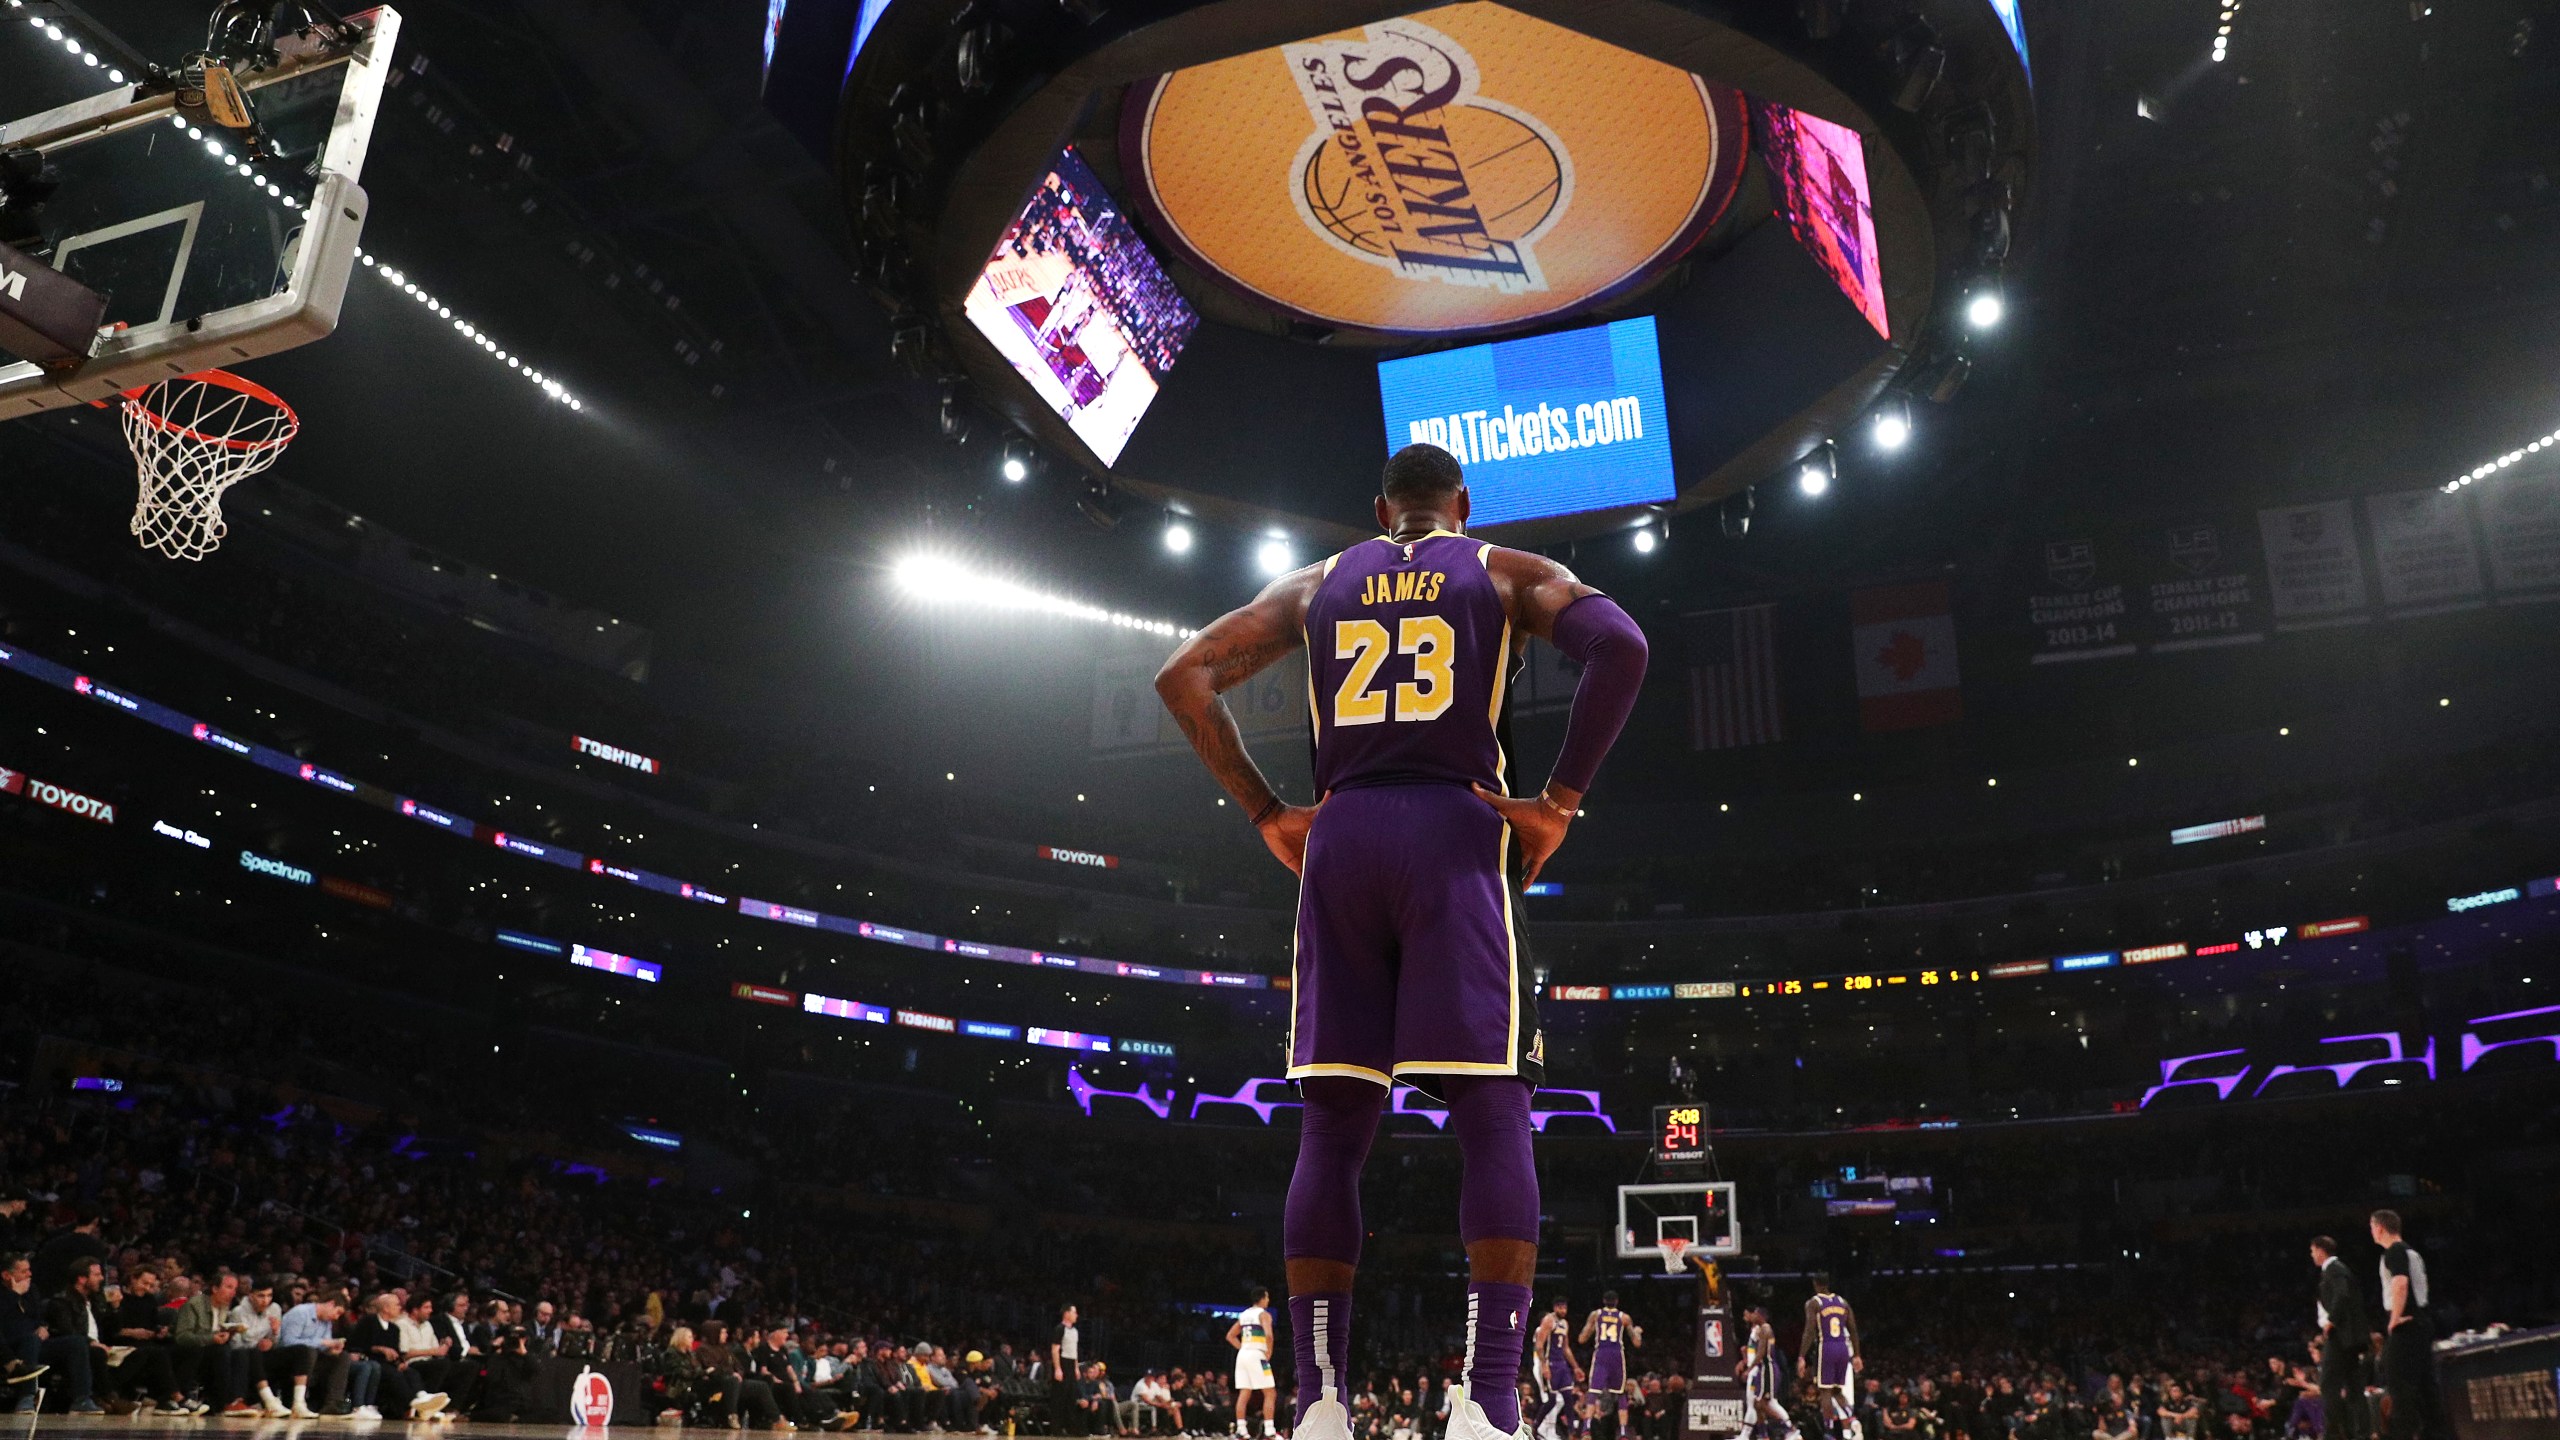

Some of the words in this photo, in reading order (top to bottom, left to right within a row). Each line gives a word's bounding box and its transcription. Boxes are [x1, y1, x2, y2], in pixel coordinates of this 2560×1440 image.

[1302, 57, 1383, 189] ANGELES
[1341, 30, 1531, 284] LAKERS
[1366, 191, 1404, 233] LOS
[1361, 571, 1446, 605] JAMES
[2170, 612, 2239, 633] 2011-12
[2048, 623, 2117, 645] 2013-14
[1334, 615, 1455, 727] 23
[578, 736, 652, 773] TOSHIBA
[30, 779, 114, 824] TOYOTA
[239, 850, 312, 885] Spectrum
[1050, 847, 1106, 867] TOYOTA
[2446, 887, 2518, 913] Spectrum
[2123, 943, 2187, 963] TOSHIBA
[1628, 986, 1671, 997] DELTA
[1675, 983, 1736, 997] STAPLES
[1785, 981, 1801, 994] 25
[1845, 976, 1872, 990] 2:08
[1922, 971, 1939, 985] 26
[897, 1010, 954, 1031] TOSHIBA
[1133, 1043, 1173, 1056] DELTA
[1669, 1108, 1700, 1125] 2:08
[1664, 1124, 1698, 1149] 24
[1672, 1150, 1705, 1160] TISSOT
[1600, 1322, 1618, 1343] 14
[1829, 1316, 1841, 1338] 6
